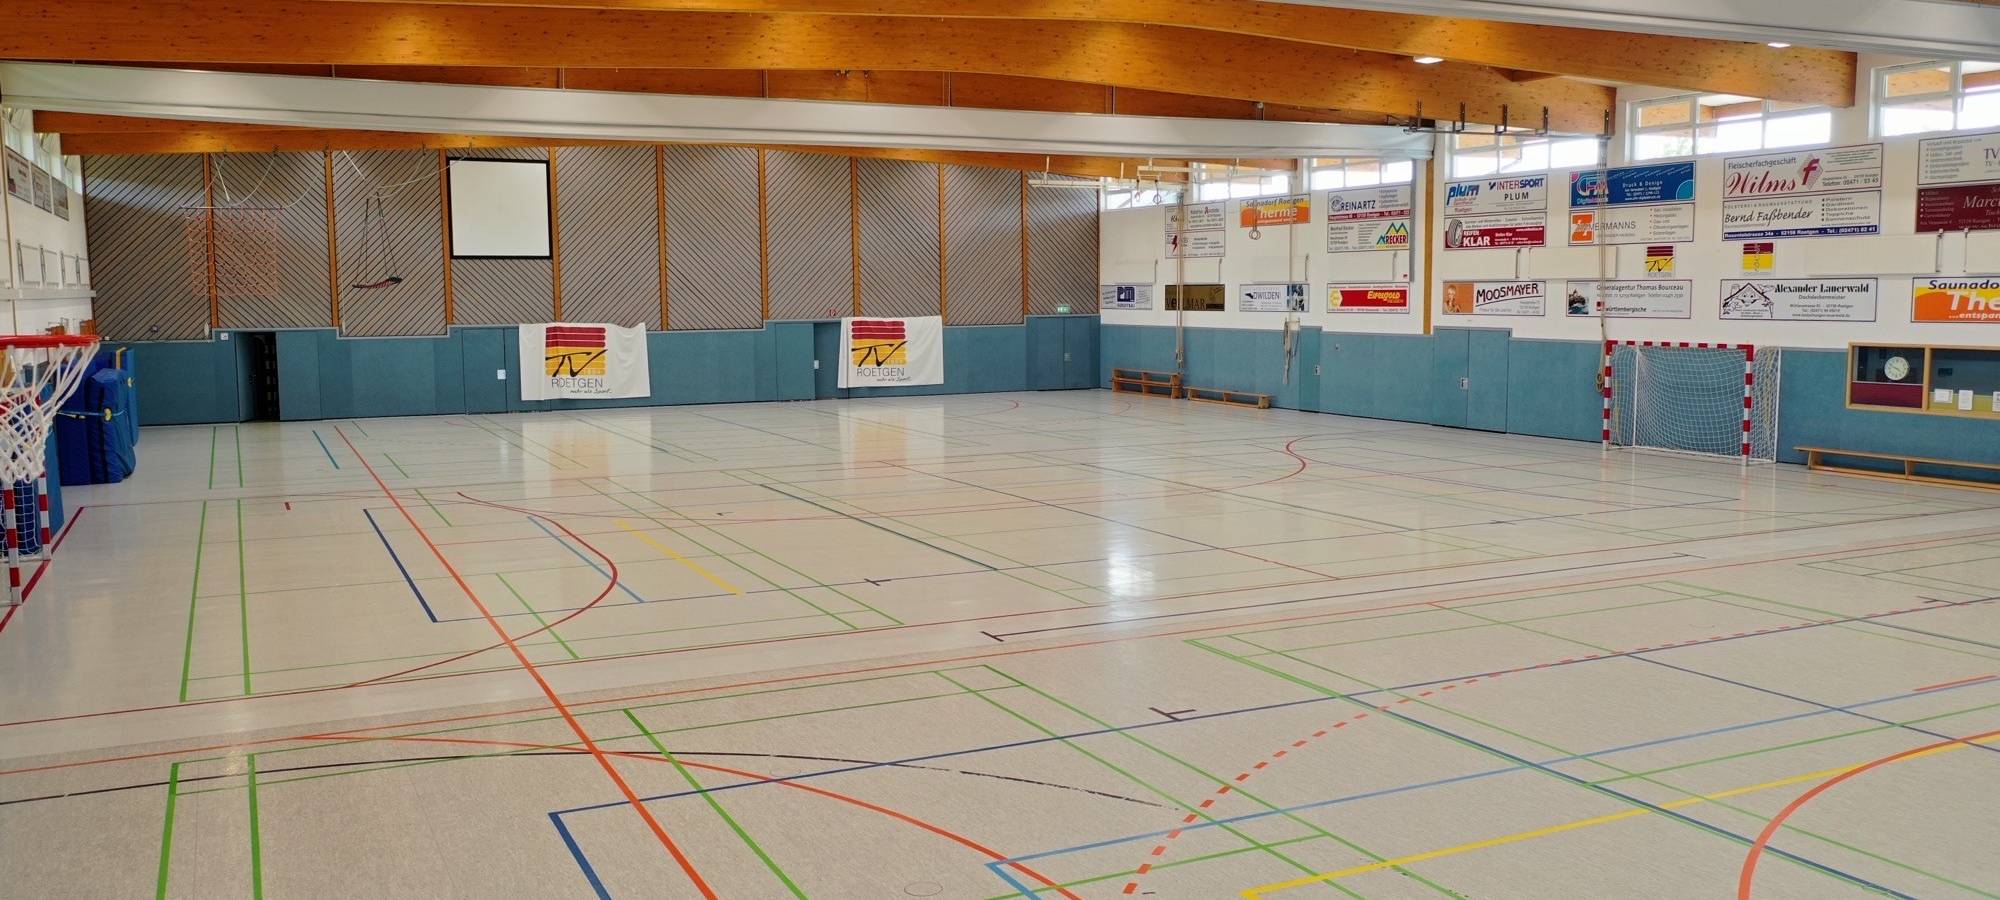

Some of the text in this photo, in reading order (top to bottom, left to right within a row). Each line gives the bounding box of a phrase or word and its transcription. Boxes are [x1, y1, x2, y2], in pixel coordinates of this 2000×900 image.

[1496, 178, 1544, 190] INTERSPORT
[1725, 170, 1796, 195] Wilms
[1447, 184, 1480, 206] plum
[1504, 192, 1529, 200] PLUM
[1340, 200, 1376, 211] REINARTZ
[1963, 195, 2000, 208] Marc
[1724, 206, 1814, 227] Bernd Faßbender
[1463, 236, 1491, 247] KLAR
[1476, 283, 1539, 303] MOOSMAYER
[1774, 284, 1869, 293] Alexander Lauerwald
[857, 368, 905, 377] ROETGEN
[552, 378, 604, 388] ROETGEN
